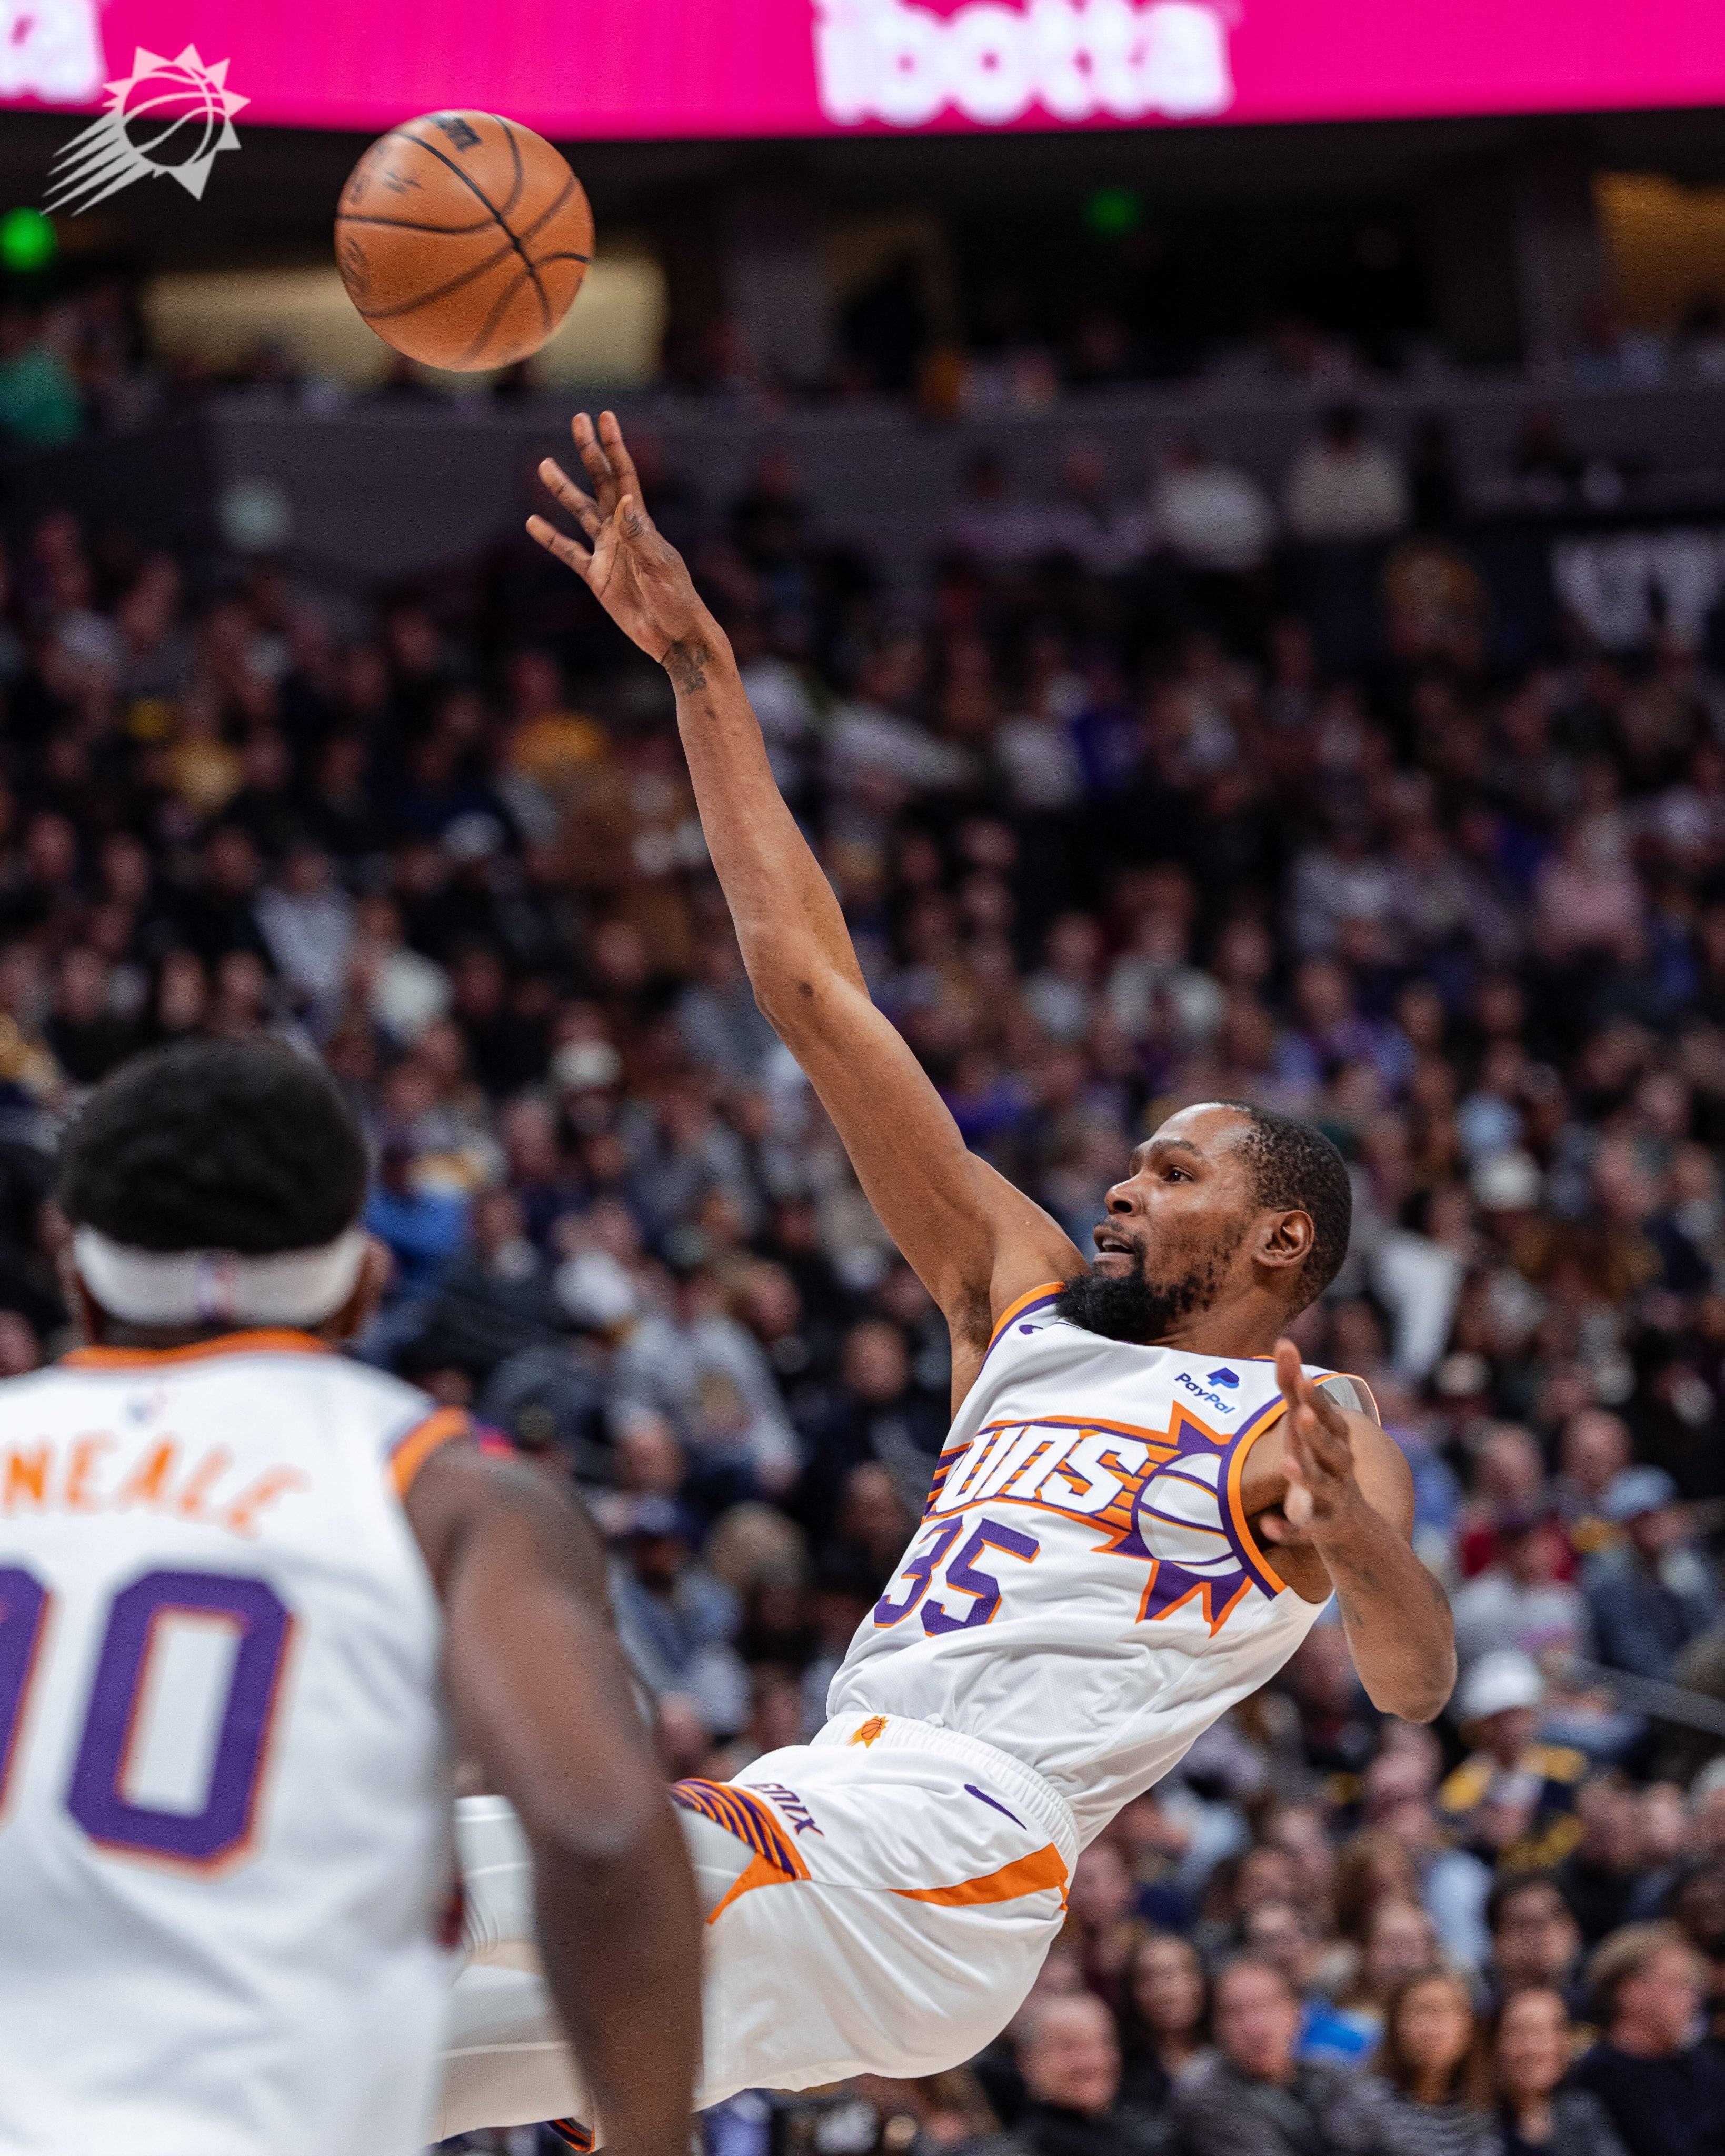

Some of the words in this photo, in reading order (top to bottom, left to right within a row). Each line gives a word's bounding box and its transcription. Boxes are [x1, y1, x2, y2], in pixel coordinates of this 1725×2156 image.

[814, 0, 1232, 124] ibotta
[1174, 1372, 1235, 1414] PayPal
[935, 1424, 1149, 1514] UNS
[874, 1515, 1040, 1637] 35
